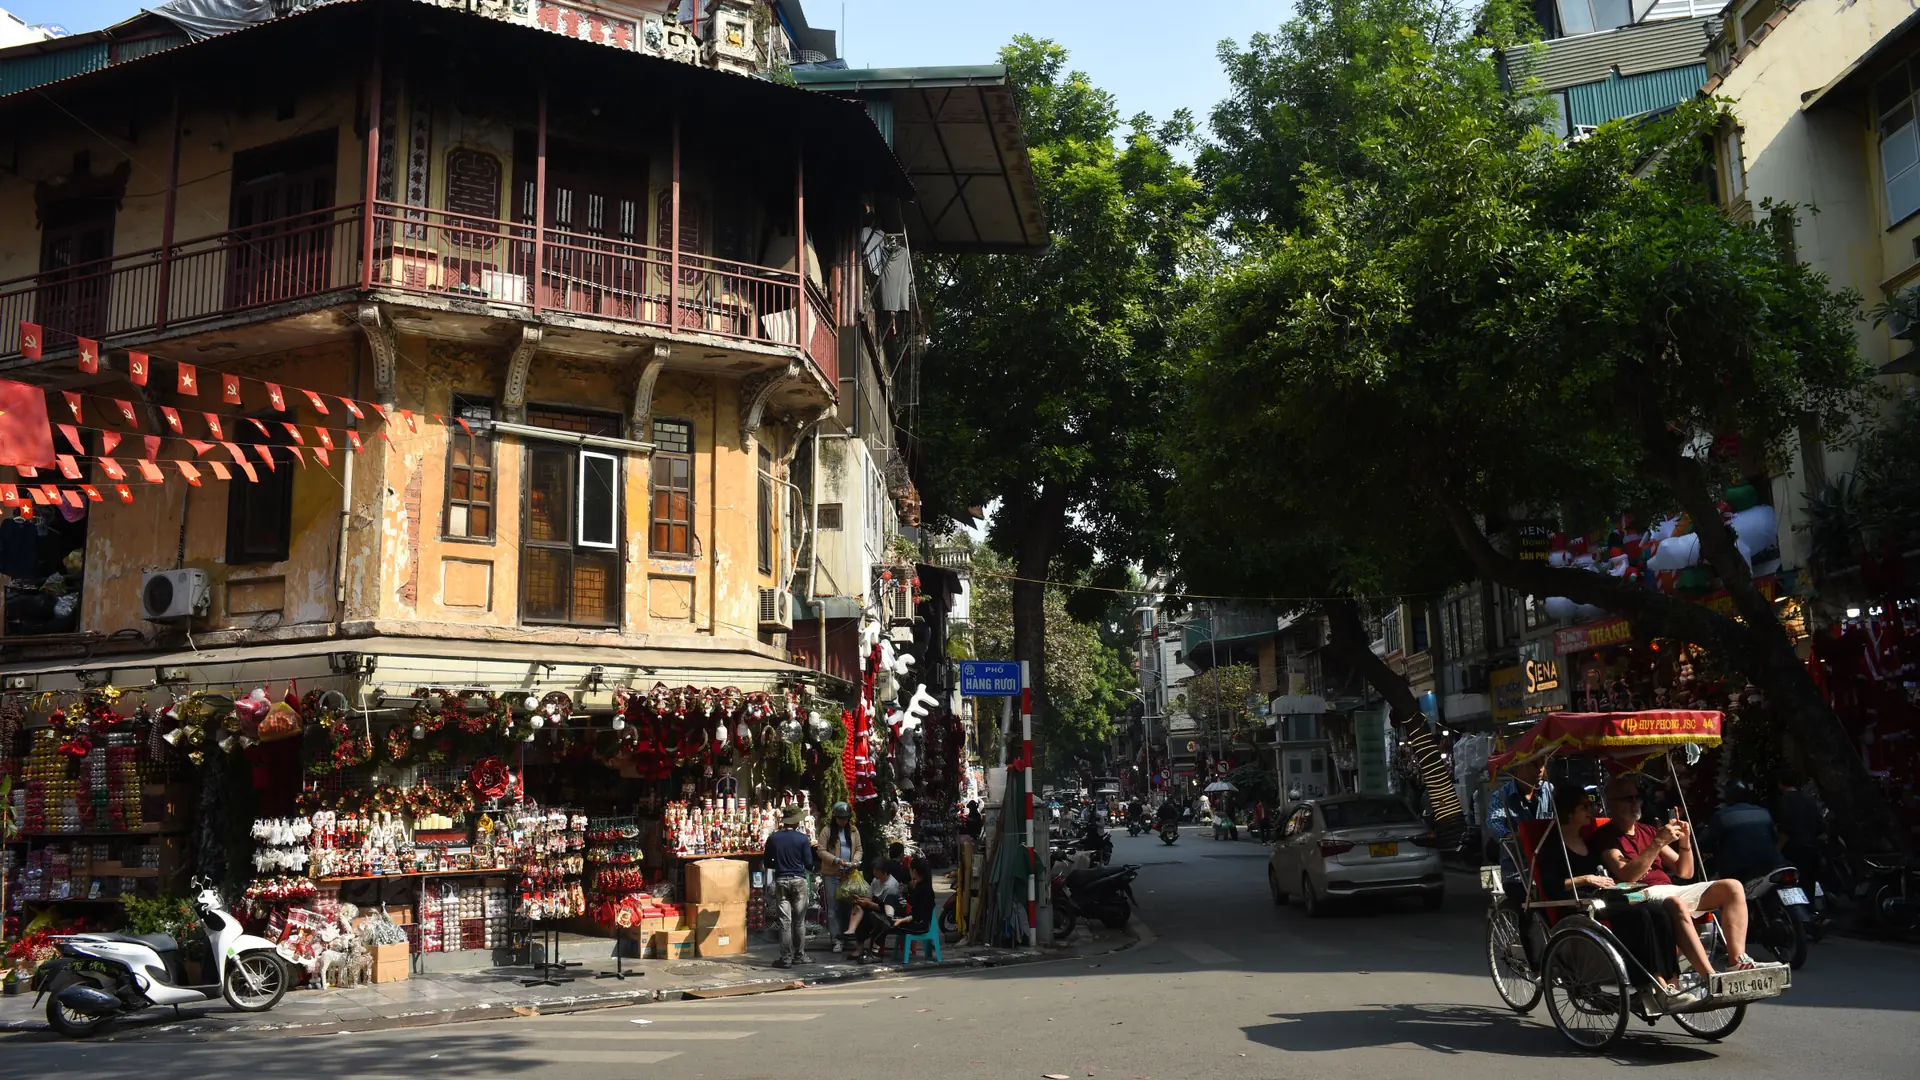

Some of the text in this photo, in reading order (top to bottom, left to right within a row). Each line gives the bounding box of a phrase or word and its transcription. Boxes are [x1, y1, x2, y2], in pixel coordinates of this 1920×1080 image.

[1588, 620, 1632, 645] THANH
[985, 664, 1004, 674] PHỐ
[966, 676, 1016, 690] HÀNG RƯƠI
[1639, 719, 1655, 730] HUY
[1702, 718, 1714, 729] 44
